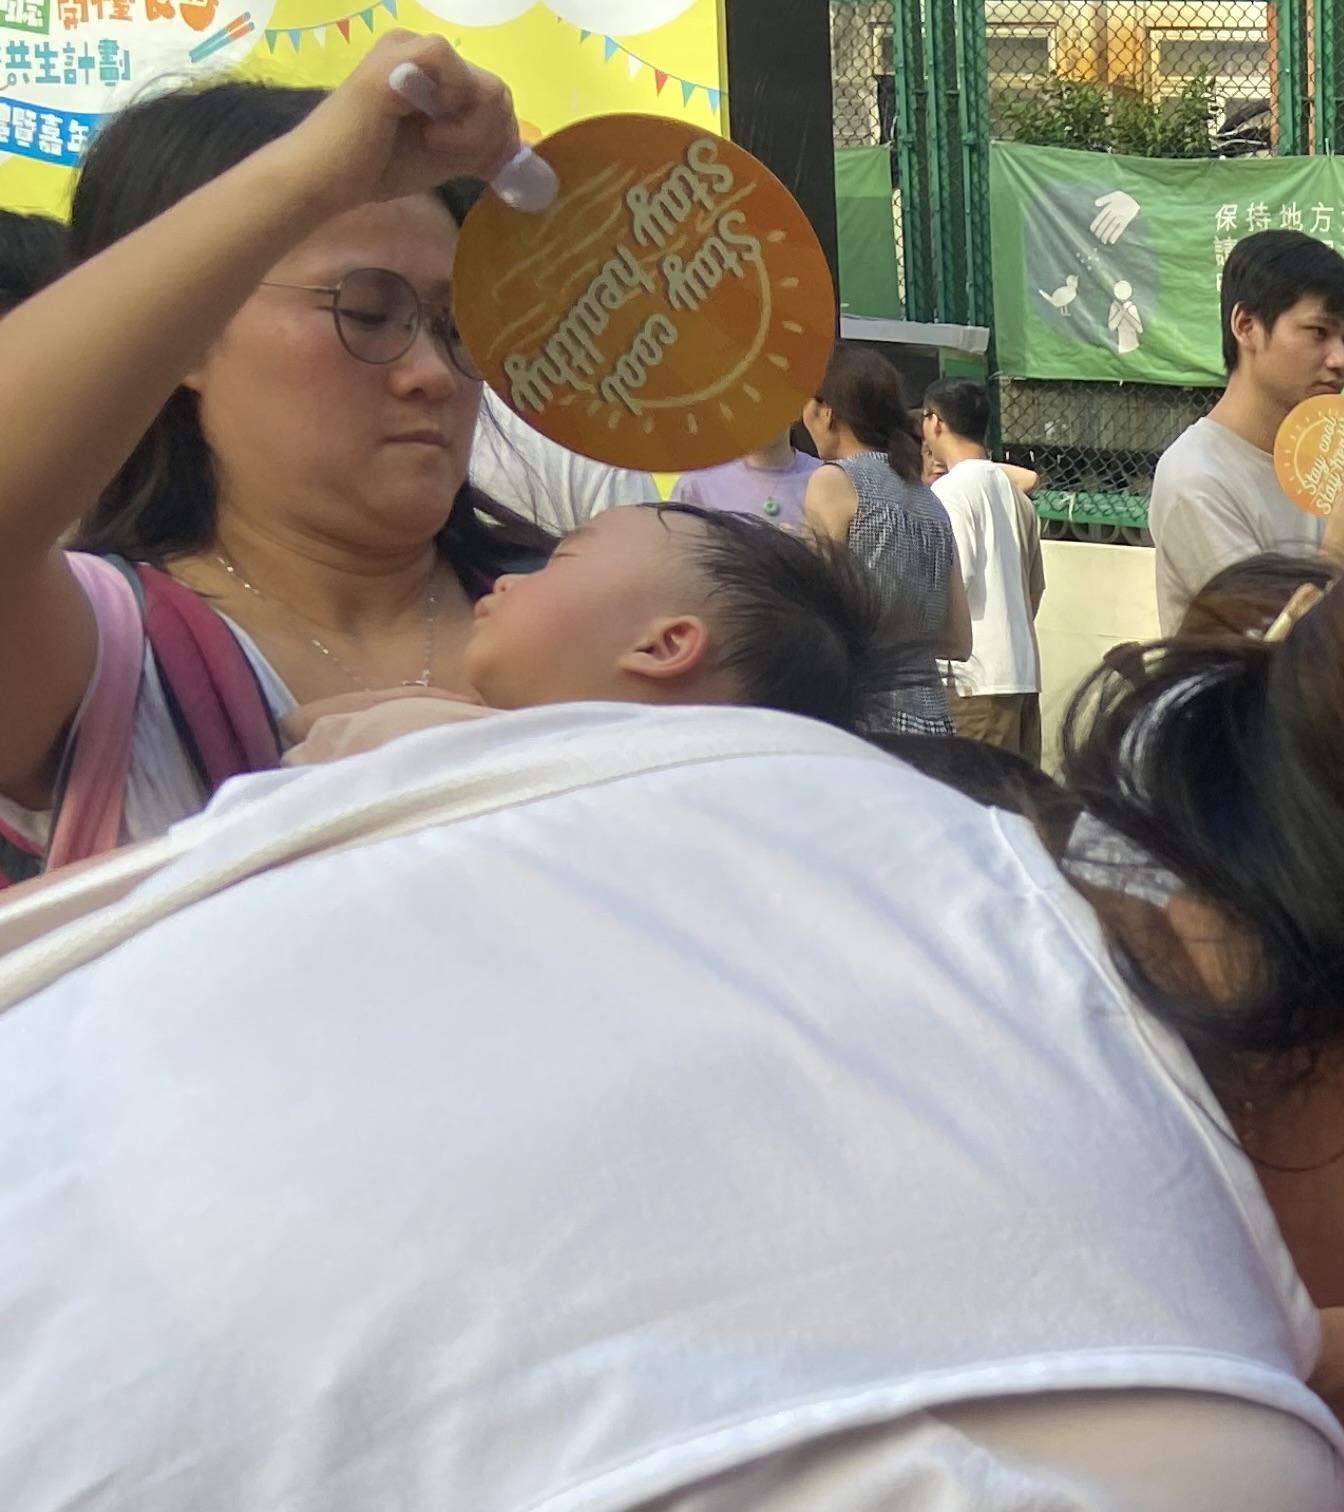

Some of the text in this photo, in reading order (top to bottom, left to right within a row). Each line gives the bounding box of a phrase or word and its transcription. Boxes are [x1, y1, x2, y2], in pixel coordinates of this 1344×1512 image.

[6, 39, 130, 87] 共生計劃
[504, 138, 733, 414] Stay healthy
[602, 211, 761, 416] Stay cool
[1303, 455, 1329, 495] Stay
[1316, 472, 1343, 514] Stay
